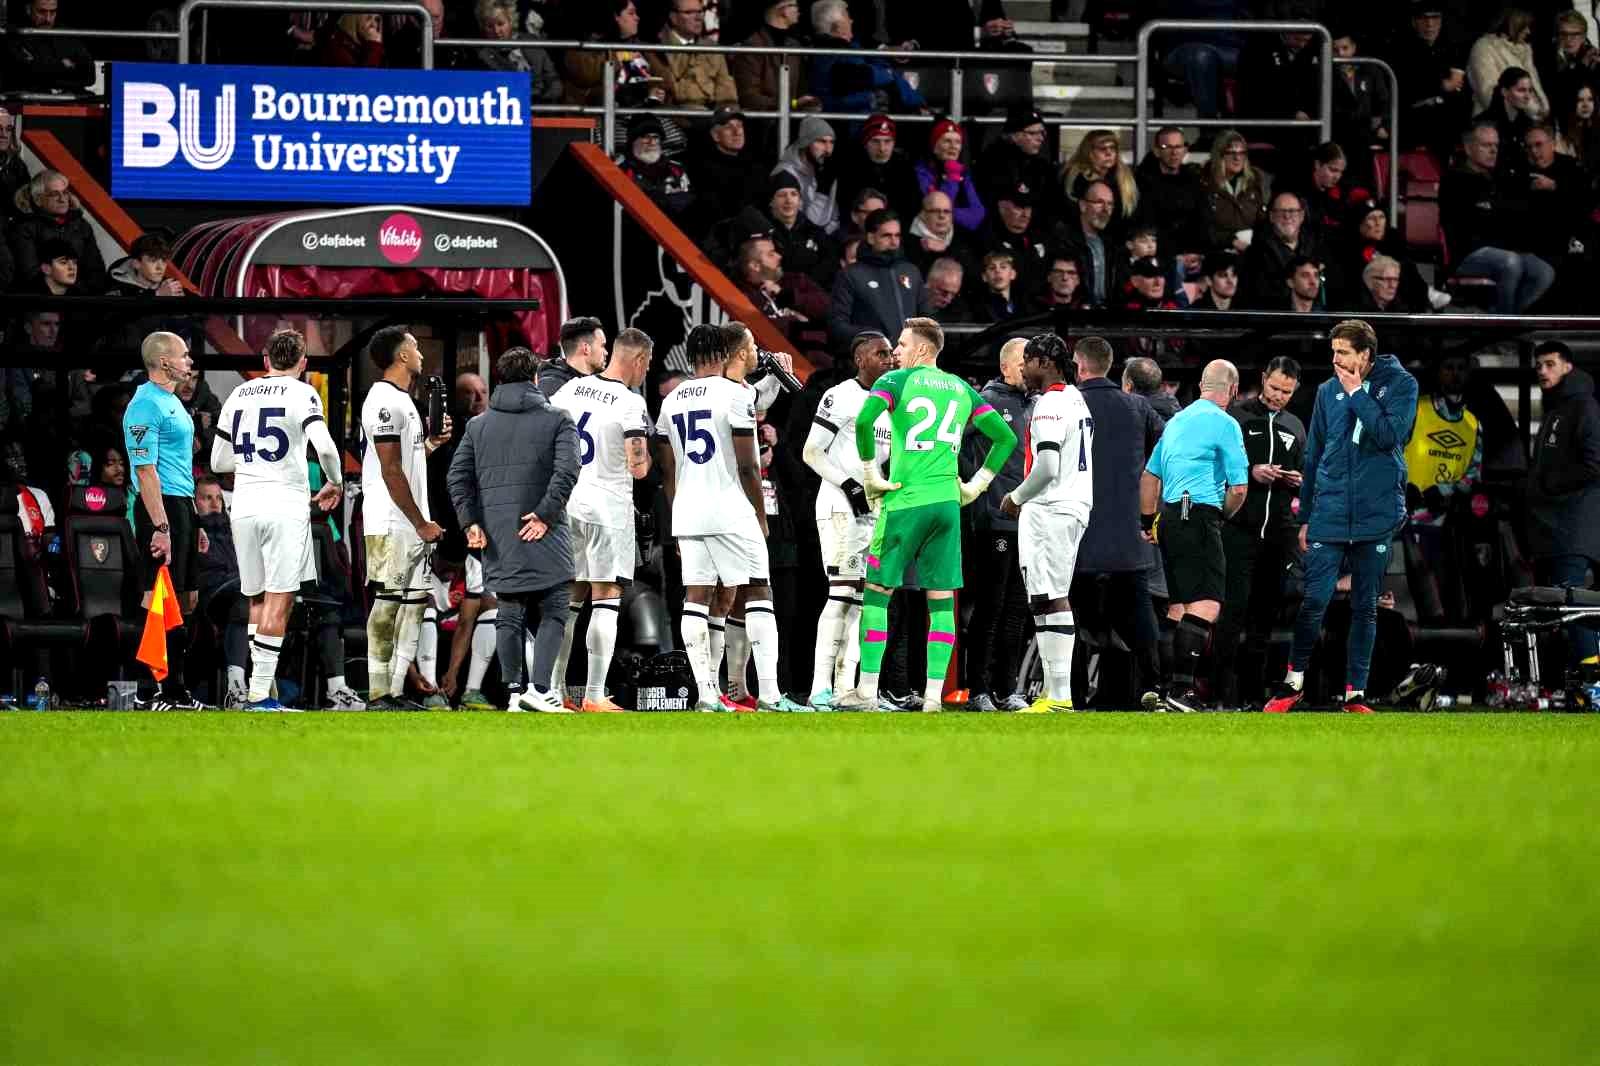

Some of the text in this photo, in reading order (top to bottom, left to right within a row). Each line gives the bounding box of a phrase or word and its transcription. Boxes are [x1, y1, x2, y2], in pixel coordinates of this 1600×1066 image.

[252, 84, 523, 126] Bournemouth
[123, 82, 236, 170] BU
[252, 132, 460, 184] University
[320, 233, 366, 248] dafabet
[380, 225, 422, 252] Vitality
[452, 235, 498, 249] dafabet
[239, 384, 287, 397] DOUGHTY
[574, 385, 618, 405] BARKLEY
[677, 386, 707, 400] MENGI
[232, 407, 289, 462] 45
[672, 409, 716, 464] 15
[906, 396, 960, 454] 24
[1428, 449, 1462, 461] umbro
